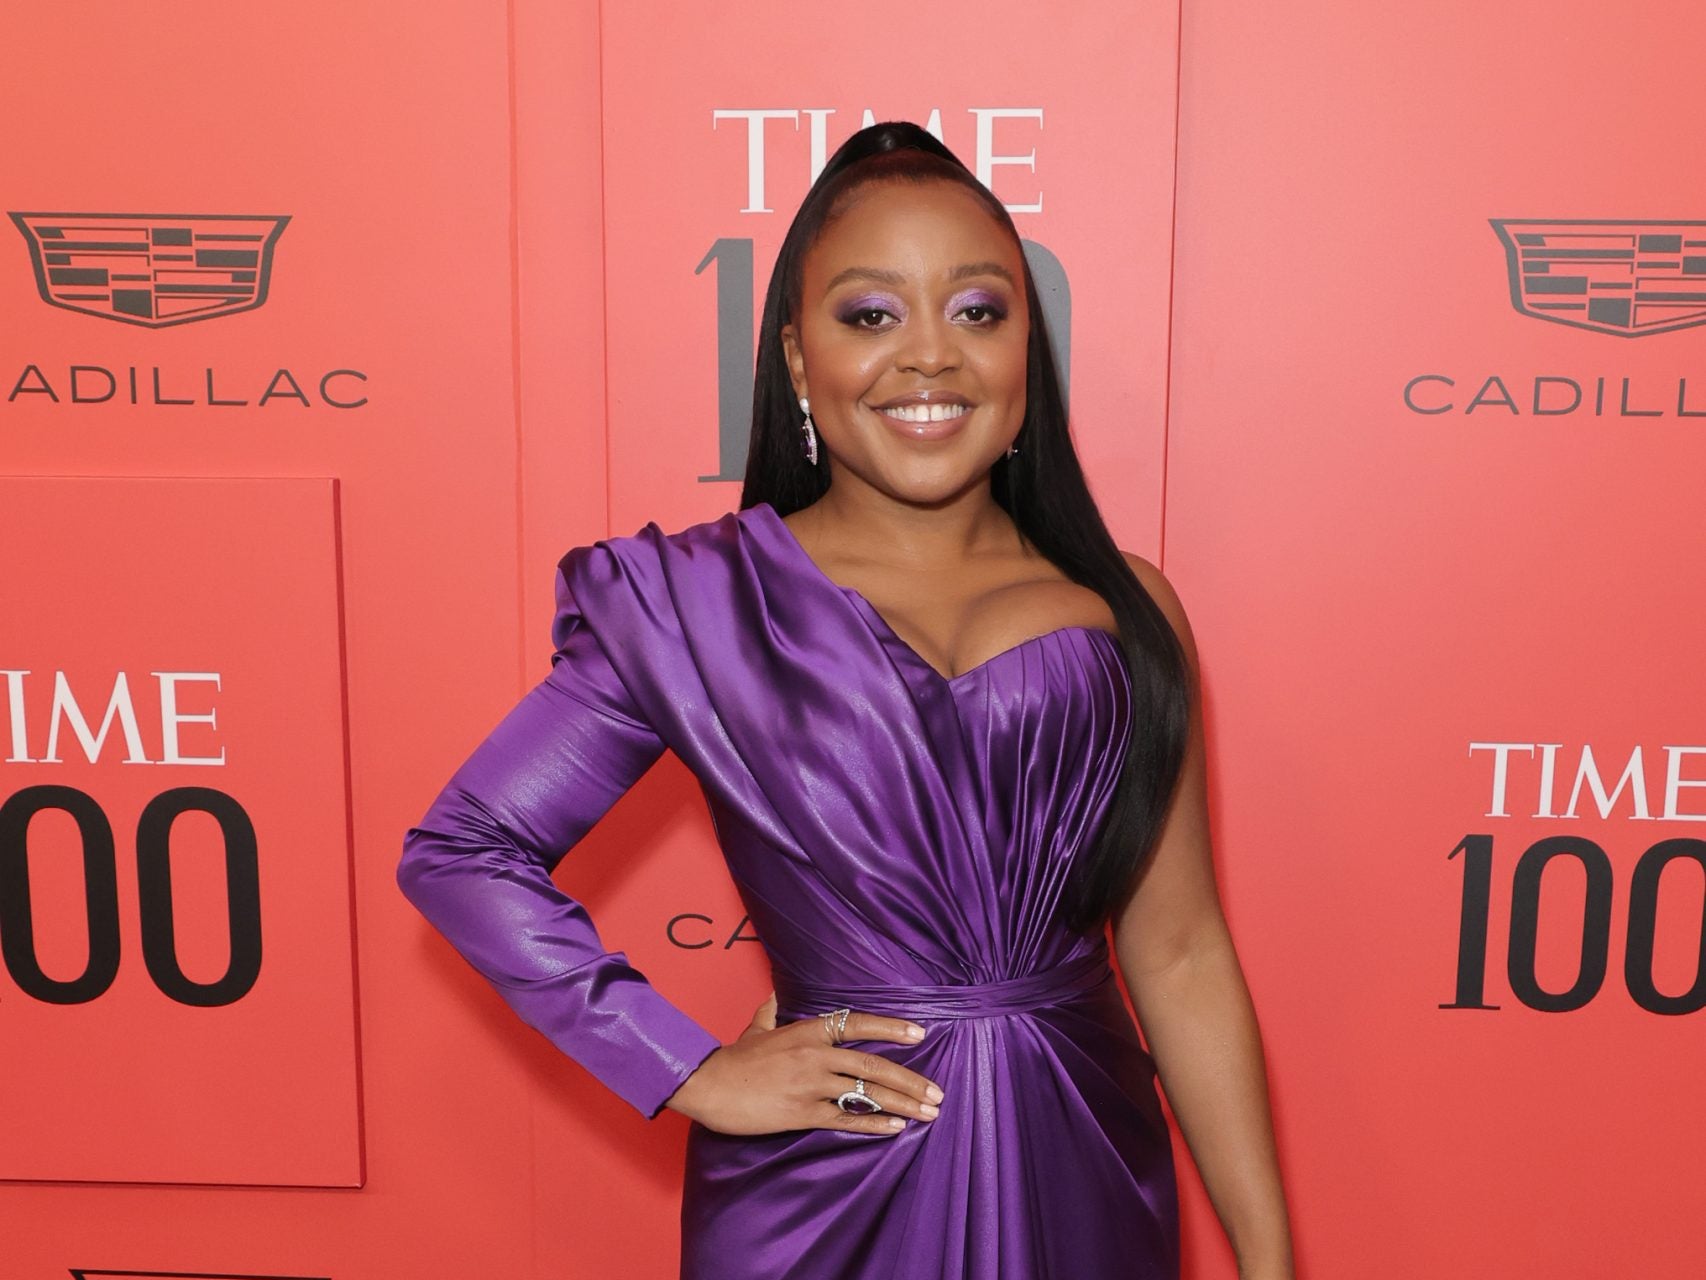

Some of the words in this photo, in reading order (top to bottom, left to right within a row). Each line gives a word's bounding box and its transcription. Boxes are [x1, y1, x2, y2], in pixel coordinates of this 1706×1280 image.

[712, 107, 1043, 213] TIE
[8, 364, 368, 409] ADILLAC
[1403, 374, 1706, 417] CADILL
[0, 669, 226, 766] IME
[1468, 741, 1706, 822] TIME
[0, 784, 263, 1008] 00
[1438, 834, 1706, 1016] 100
